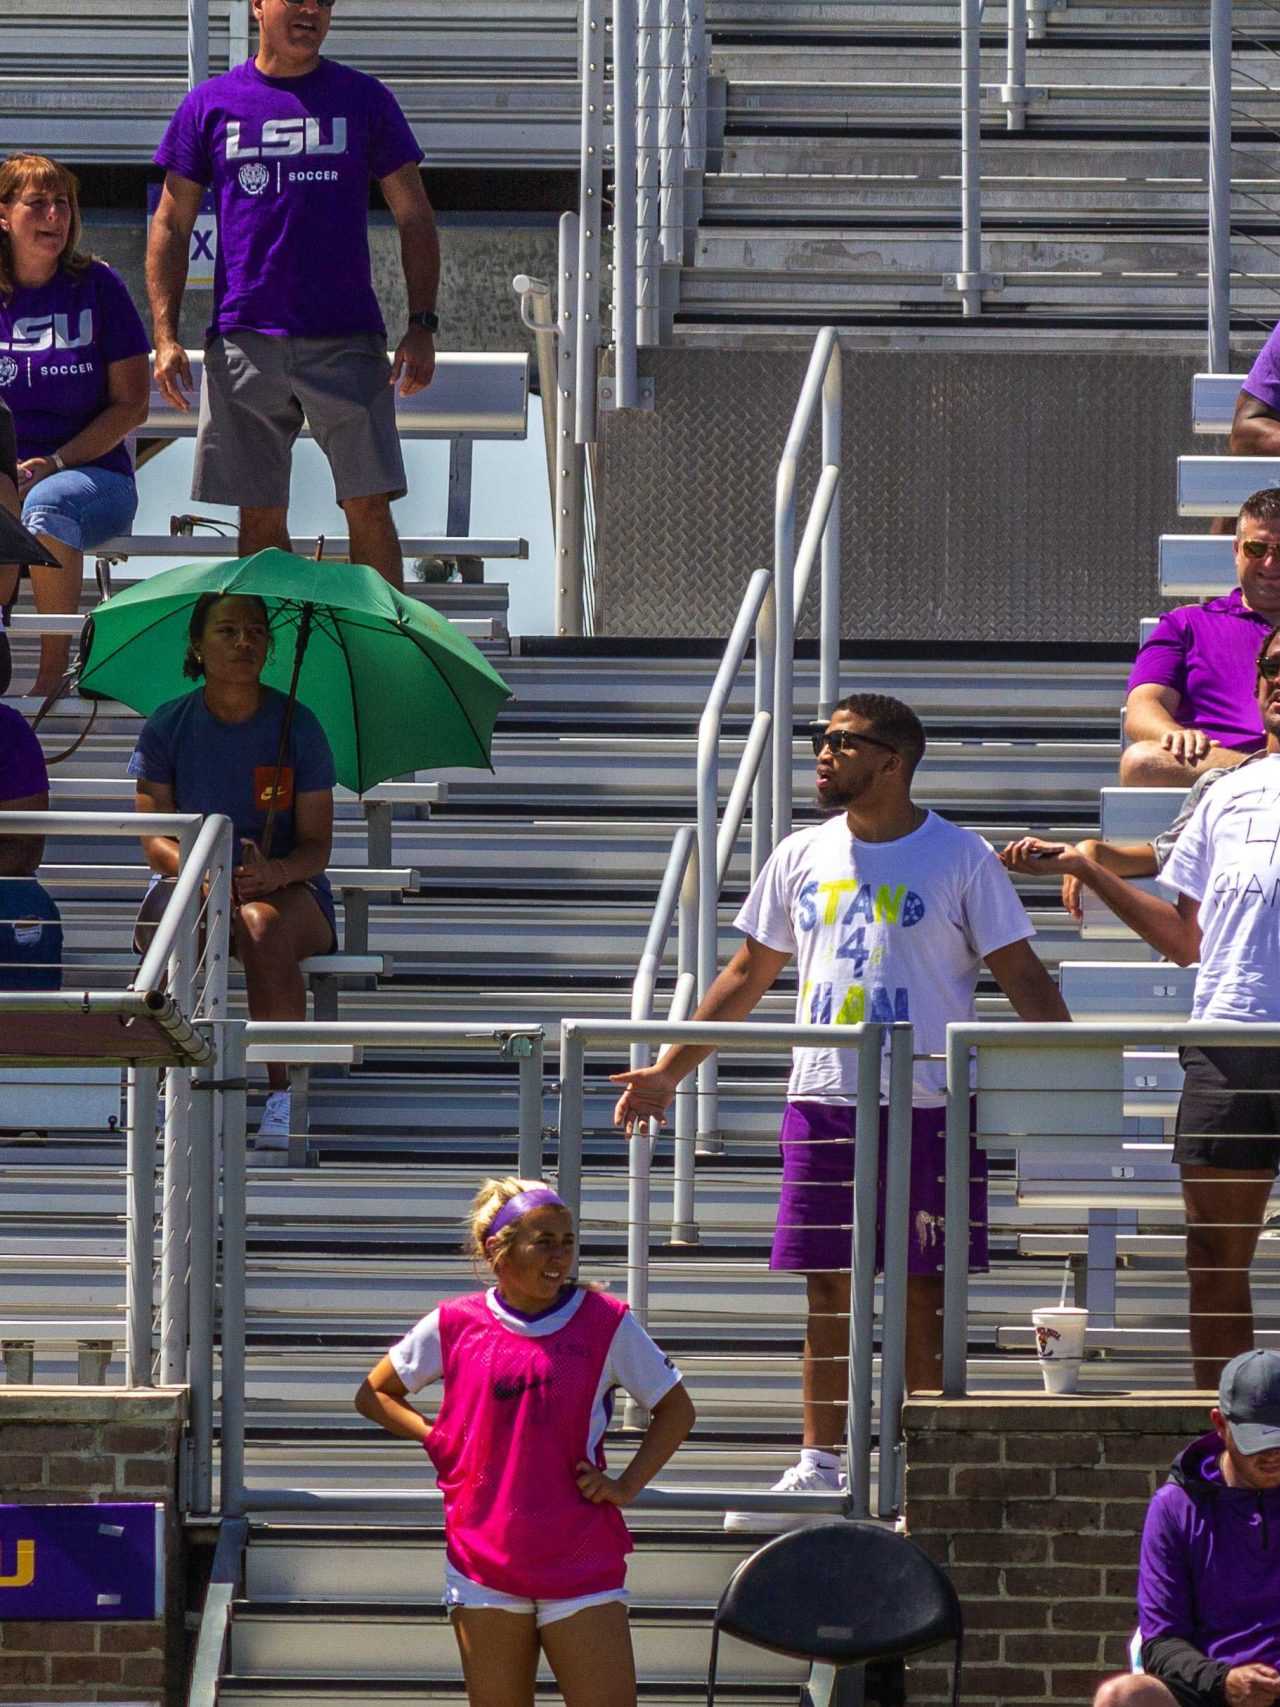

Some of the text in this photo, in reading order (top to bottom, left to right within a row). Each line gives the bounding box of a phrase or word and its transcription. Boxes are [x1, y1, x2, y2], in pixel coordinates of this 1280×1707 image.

[226, 117, 347, 160] LSU
[288, 170, 339, 181] SOCCER
[0, 309, 93, 352] SU
[40, 362, 94, 376] SOCCER
[799, 880, 926, 932] STAND
[836, 927, 870, 979] 4
